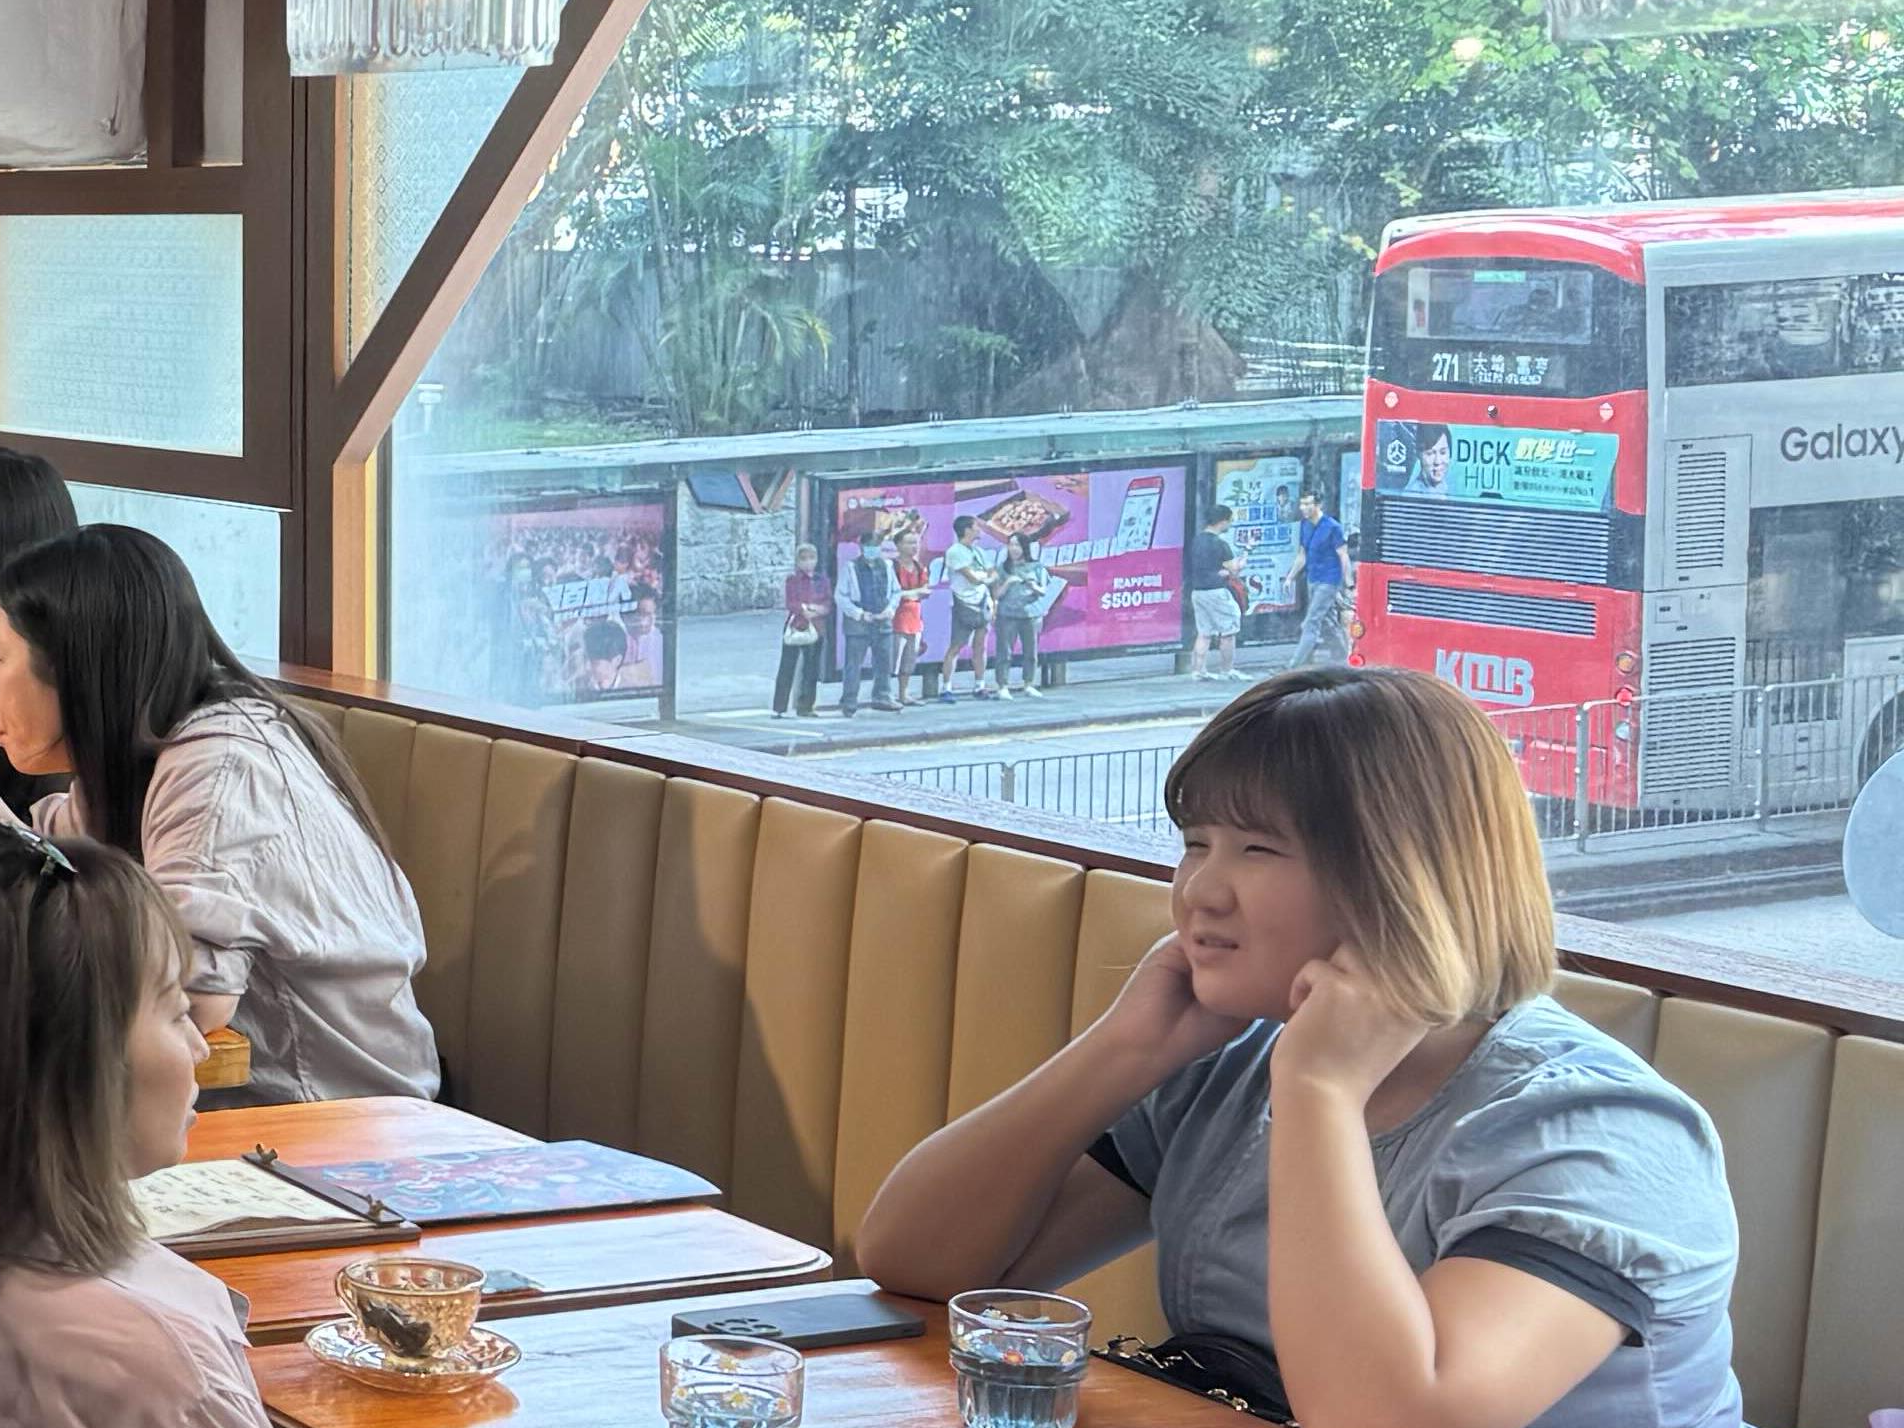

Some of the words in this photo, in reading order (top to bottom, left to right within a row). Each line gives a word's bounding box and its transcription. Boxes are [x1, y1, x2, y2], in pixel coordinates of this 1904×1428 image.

[1432, 353, 1459, 381] 271
[1457, 439, 1511, 466] DICK
[1464, 466, 1502, 490] HUI
[1435, 648, 1534, 706] KMB
